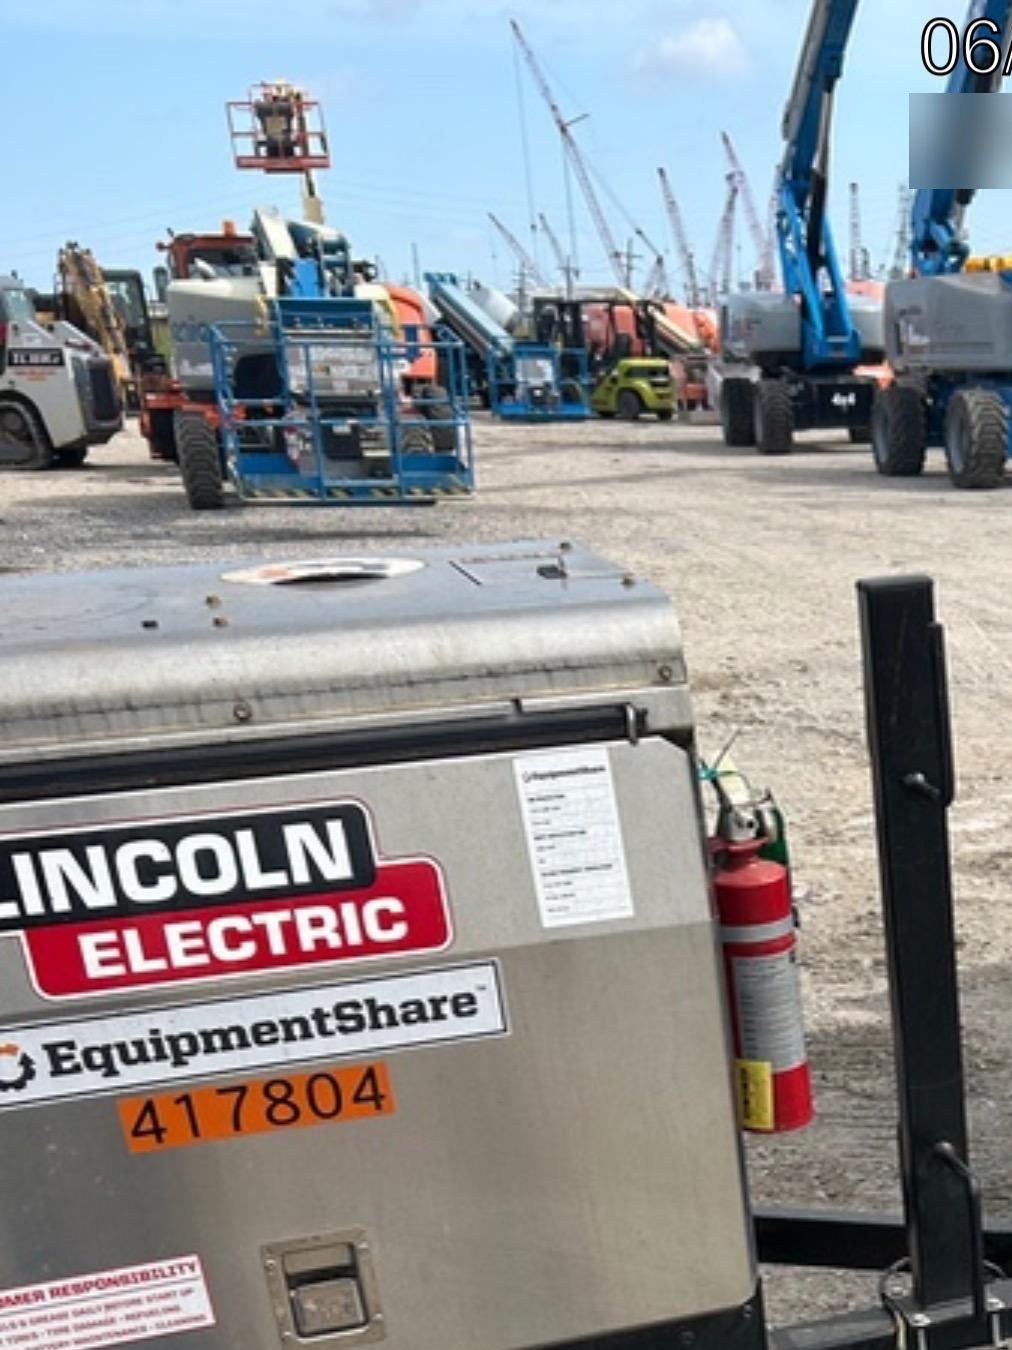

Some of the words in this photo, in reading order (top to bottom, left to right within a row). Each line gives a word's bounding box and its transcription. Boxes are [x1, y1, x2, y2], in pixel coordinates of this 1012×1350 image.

[78, 896, 408, 980] ELECTRIC
[130, 1066, 386, 1146] 417804
[49, 1261, 197, 1298] RESPONSIBILITY
